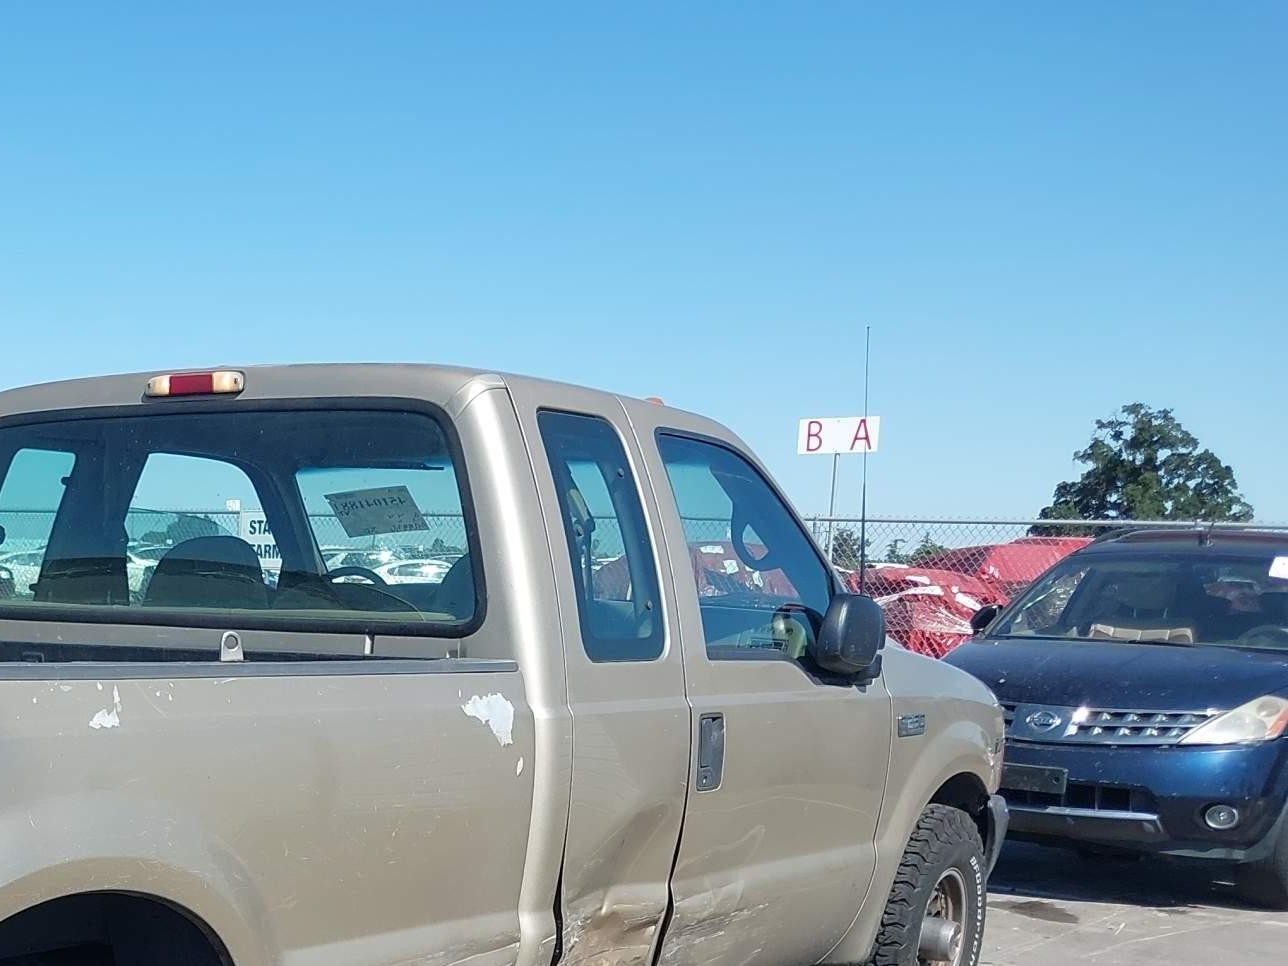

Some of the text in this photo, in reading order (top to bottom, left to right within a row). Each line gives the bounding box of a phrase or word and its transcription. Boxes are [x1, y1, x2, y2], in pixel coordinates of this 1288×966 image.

[805, 418, 872, 452] B A
[248, 519, 272, 536] STA
[251, 543, 281, 560] ARM
